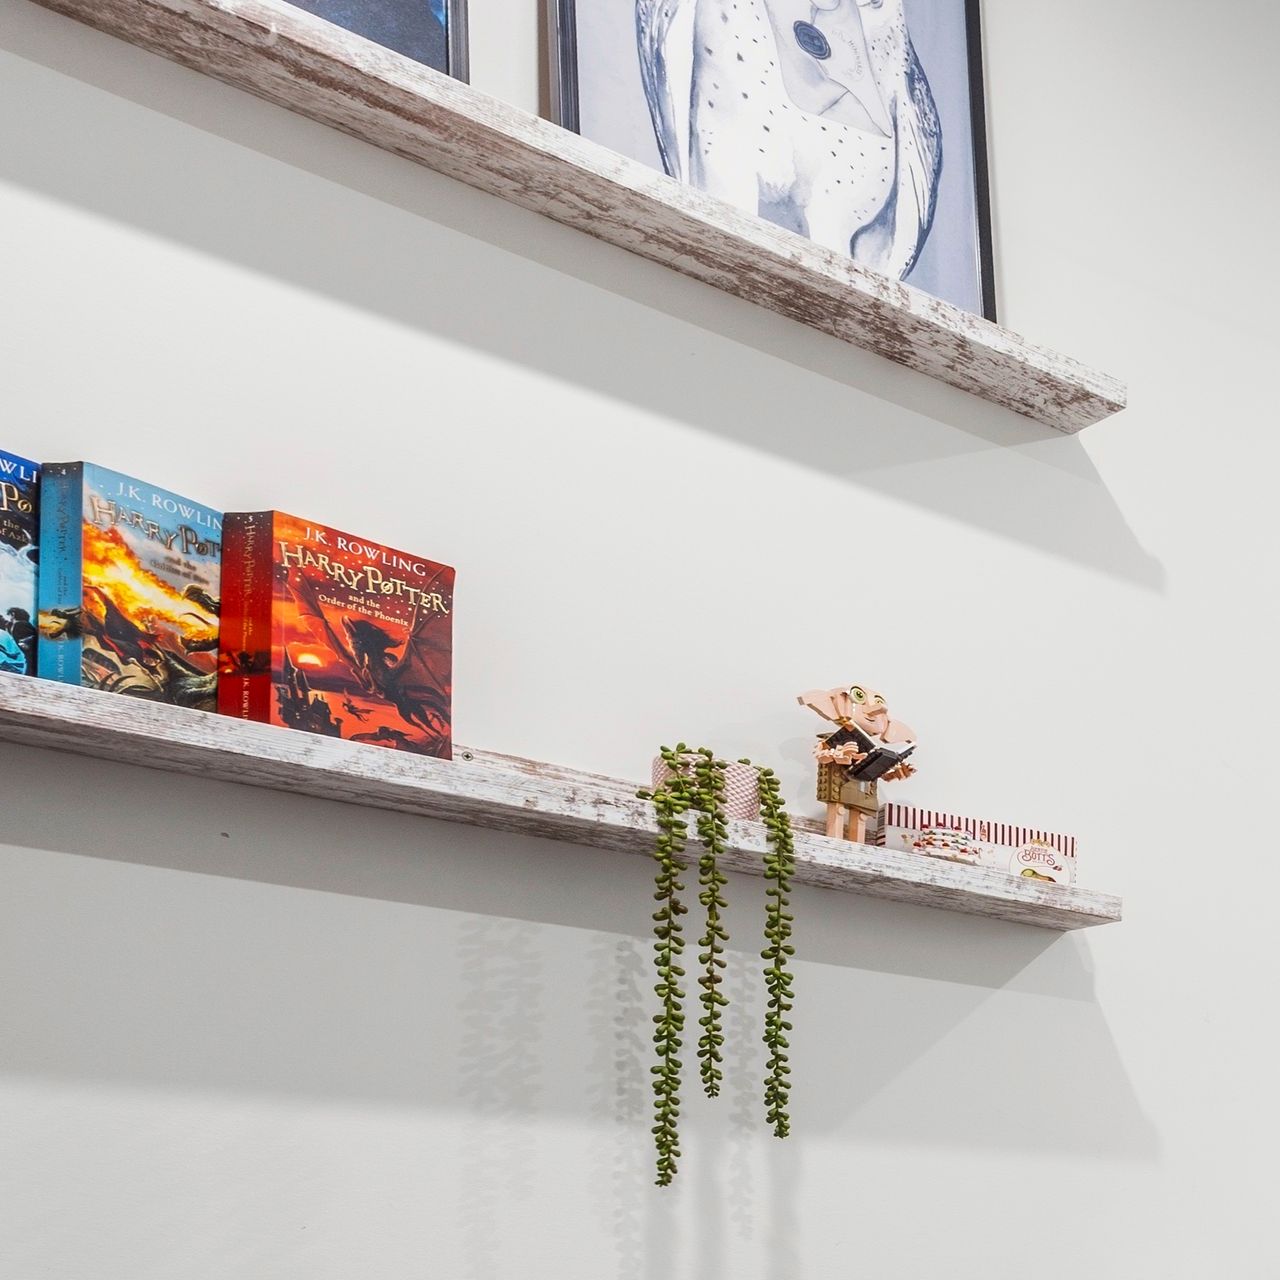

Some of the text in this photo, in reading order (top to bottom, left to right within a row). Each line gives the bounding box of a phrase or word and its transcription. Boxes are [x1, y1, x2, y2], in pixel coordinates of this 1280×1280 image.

[116, 482, 146, 502] J.K.
[89, 494, 222, 557] HARRY POT
[304, 527, 427, 577] J.K. ROWLING
[279, 541, 449, 614] HARRY POTTER
[318, 593, 409, 627] Order of the Phoenix
[348, 594, 380, 609] and the
